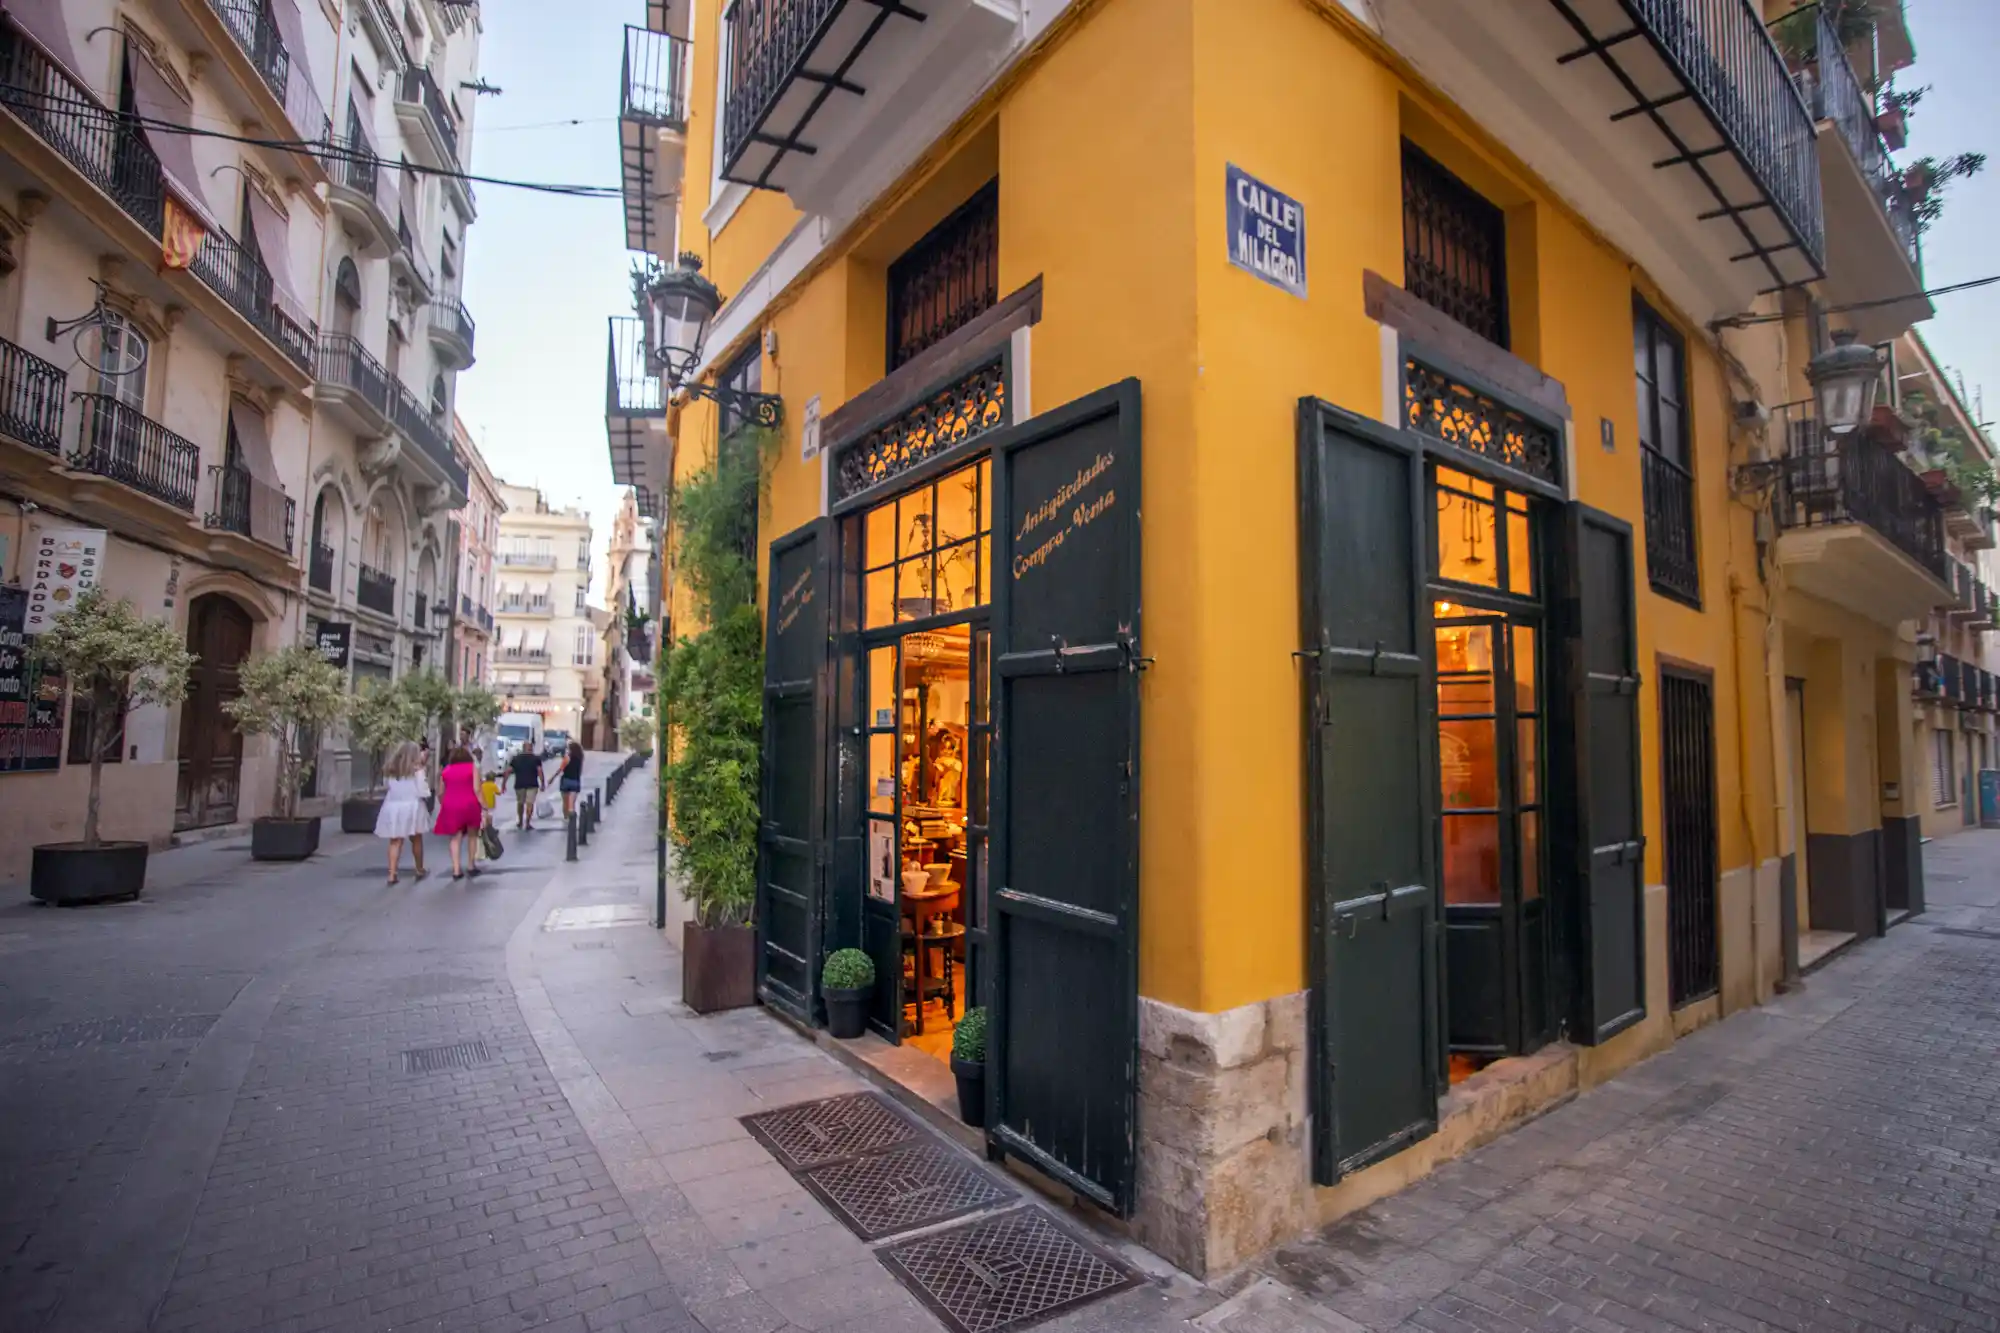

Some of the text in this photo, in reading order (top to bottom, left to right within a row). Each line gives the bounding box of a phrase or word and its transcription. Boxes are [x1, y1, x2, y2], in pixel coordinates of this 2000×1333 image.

[1236, 178, 1297, 233] CALLE
[1237, 230, 1298, 285] MILAGRO
[1257, 221, 1282, 247] DEL
[1015, 450, 1116, 541] Antigüedades
[1012, 530, 1065, 580] Compra
[1072, 488, 1116, 528] Venta
[29, 537, 56, 624] BORDADOS
[0, 626, 23, 648] Gran
